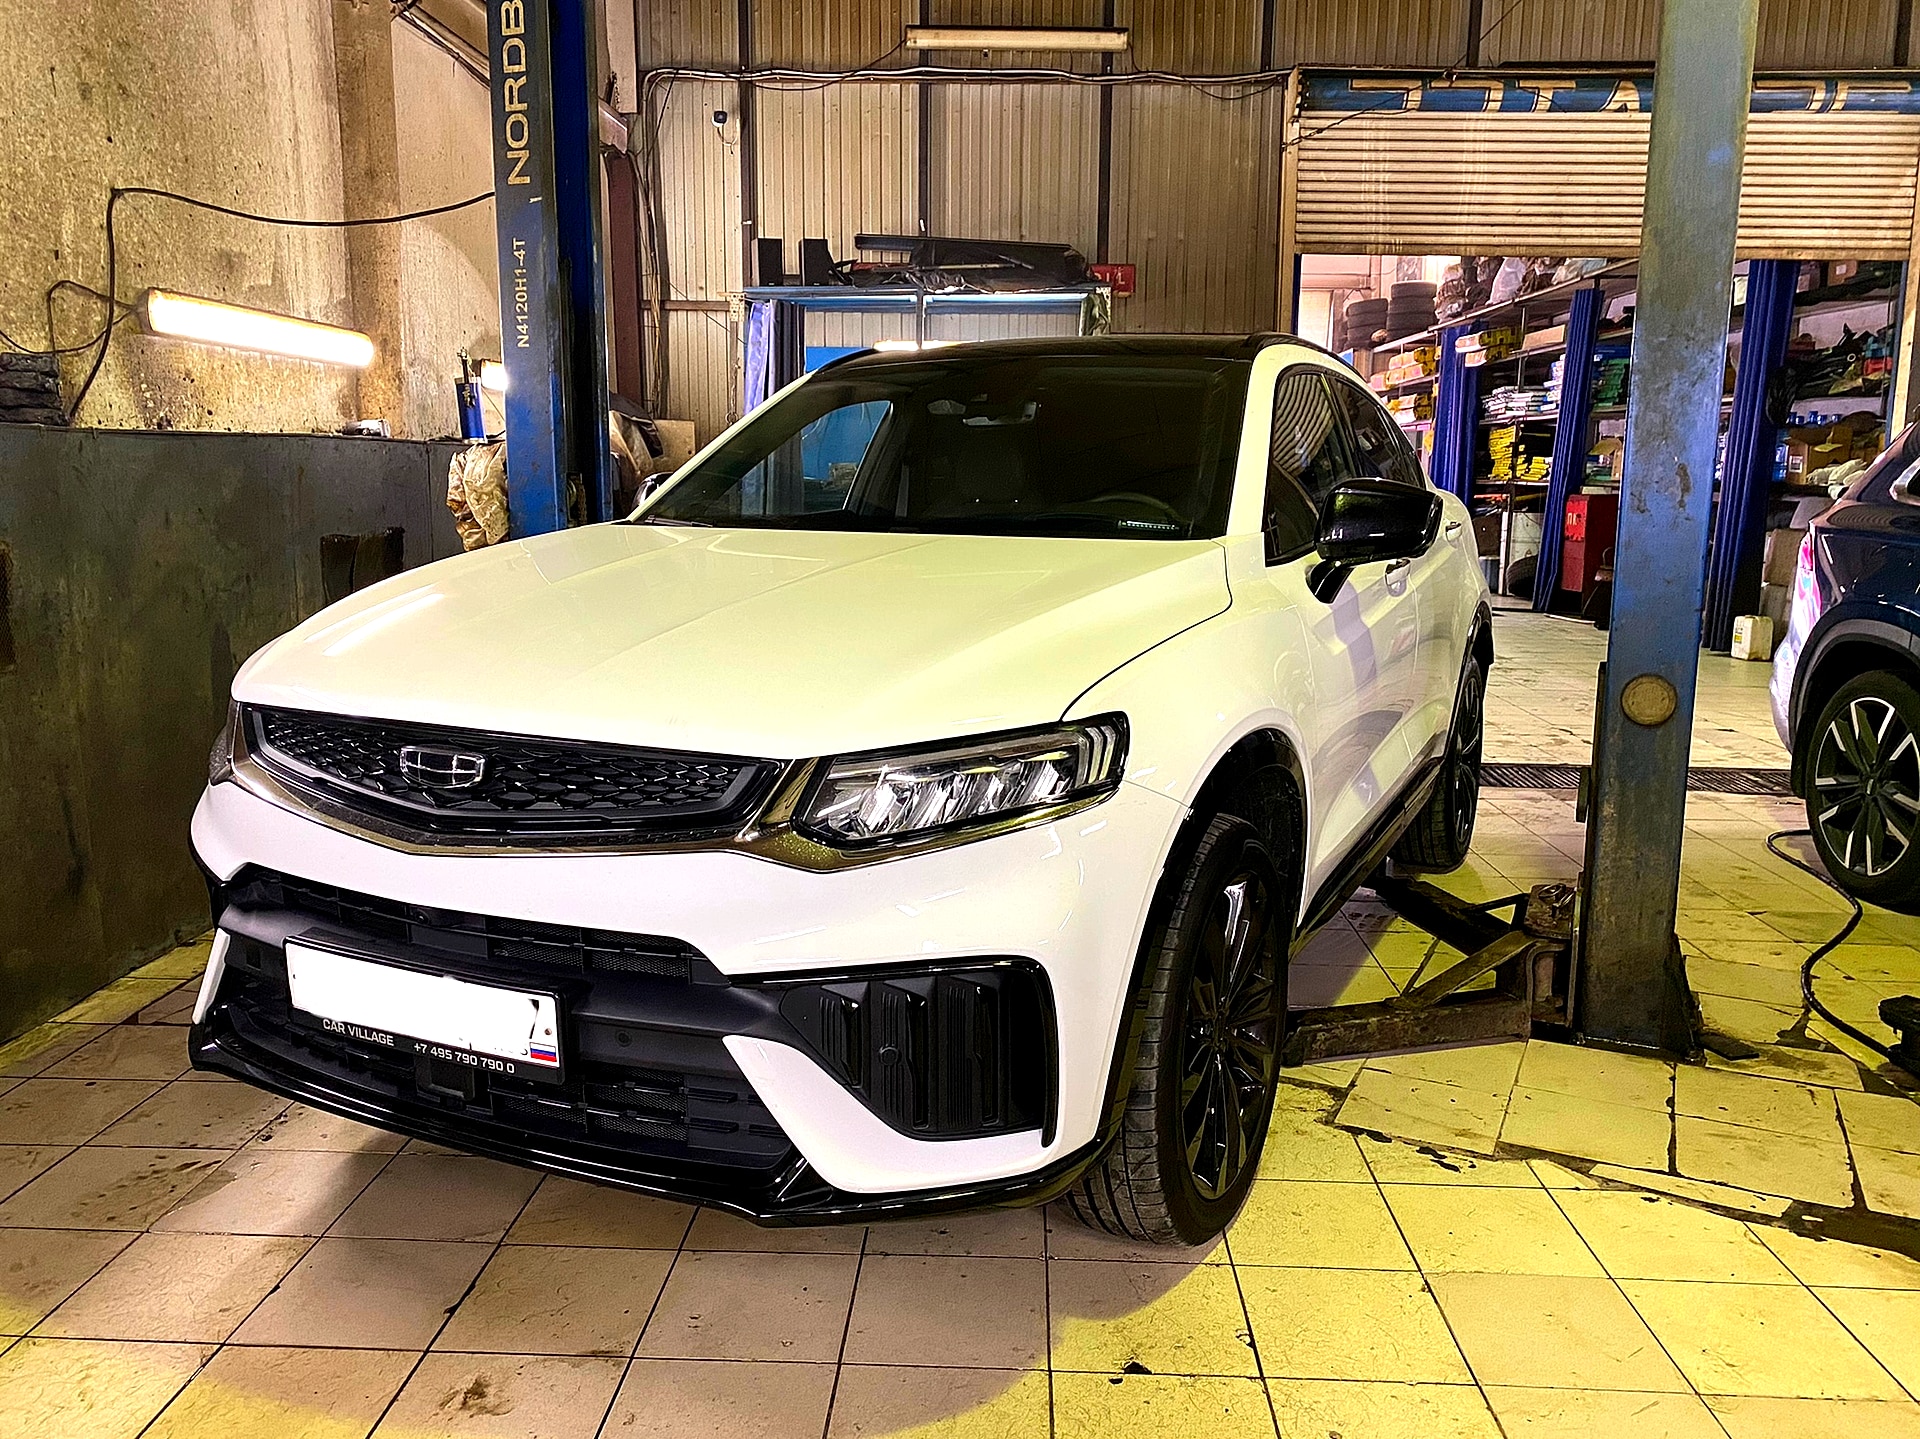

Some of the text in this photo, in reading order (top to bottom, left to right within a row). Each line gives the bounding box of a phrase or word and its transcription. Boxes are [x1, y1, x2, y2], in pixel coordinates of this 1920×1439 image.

[500, 0, 531, 185] NORDB
[513, 237, 530, 348] N4120H1-4T
[322, 1018, 515, 1074] CAR VILLAGE +7 495 790 790 0
